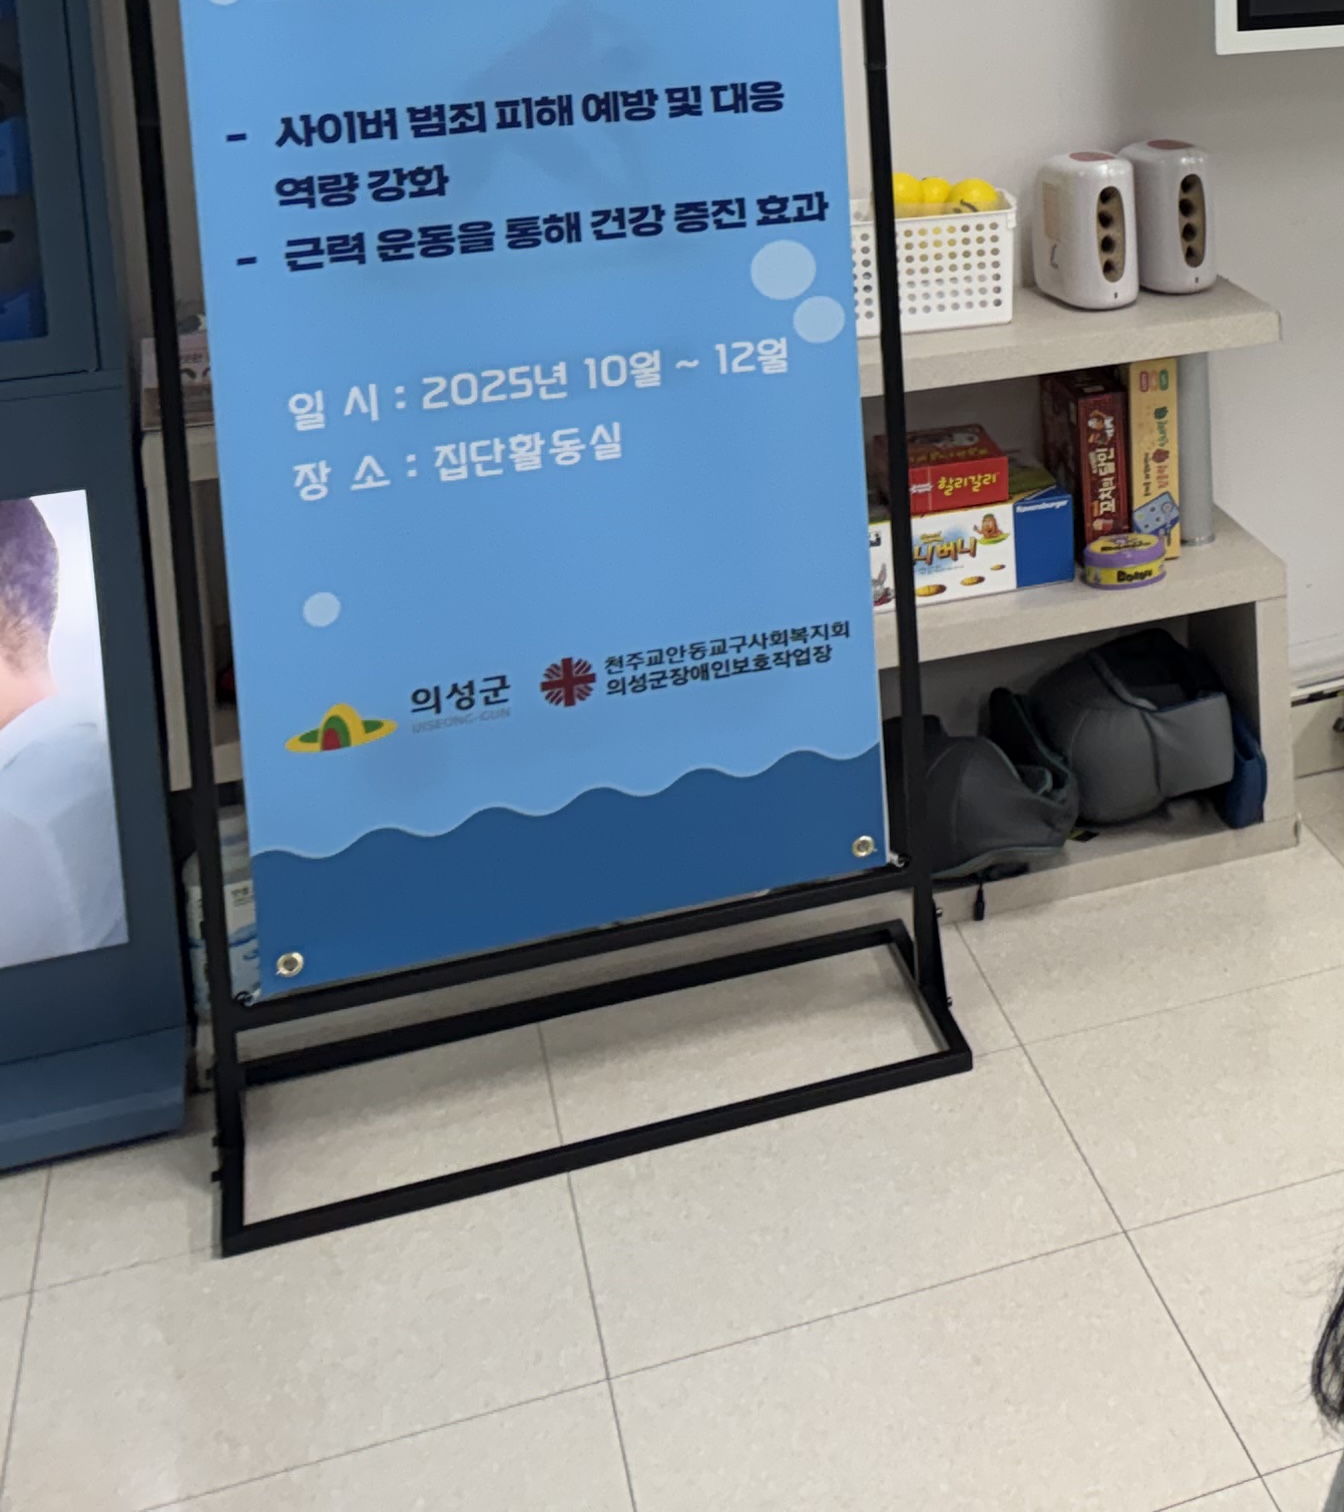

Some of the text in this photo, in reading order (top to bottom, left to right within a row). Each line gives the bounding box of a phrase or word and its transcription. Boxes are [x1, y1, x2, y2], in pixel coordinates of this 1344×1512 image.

[275, 107, 398, 149] 사이버
[408, 99, 487, 140] 범죄
[495, 92, 574, 134] 피해
[581, 86, 659, 125] 예방
[664, 83, 703, 118] 및
[710, 79, 785, 115] 대응
[275, 164, 449, 210] 역량 강화
[285, 231, 366, 273] 근력
[376, 219, 496, 264] 운동을
[505, 211, 581, 251] 통해
[590, 203, 665, 243] 건강
[673, 197, 747, 235] 증진
[755, 190, 829, 228] 효과
[288, 390, 326, 432] 일
[343, 382, 380, 422] 시
[421, 360, 568, 410] 2025년
[583, 349, 662, 391] 10월
[715, 337, 790, 376] 12월
[293, 461, 331, 502] 장
[348, 453, 391, 491] 소
[434, 420, 624, 483] 집단활동실
[938, 473, 998, 497] 할리갈리
[912, 535, 977, 566] 니버니
[604, 619, 851, 675] 천주교안동교구사회복지회
[606, 643, 833, 697] 의성군장애인보호작업장
[411, 674, 511, 714] 의성군
